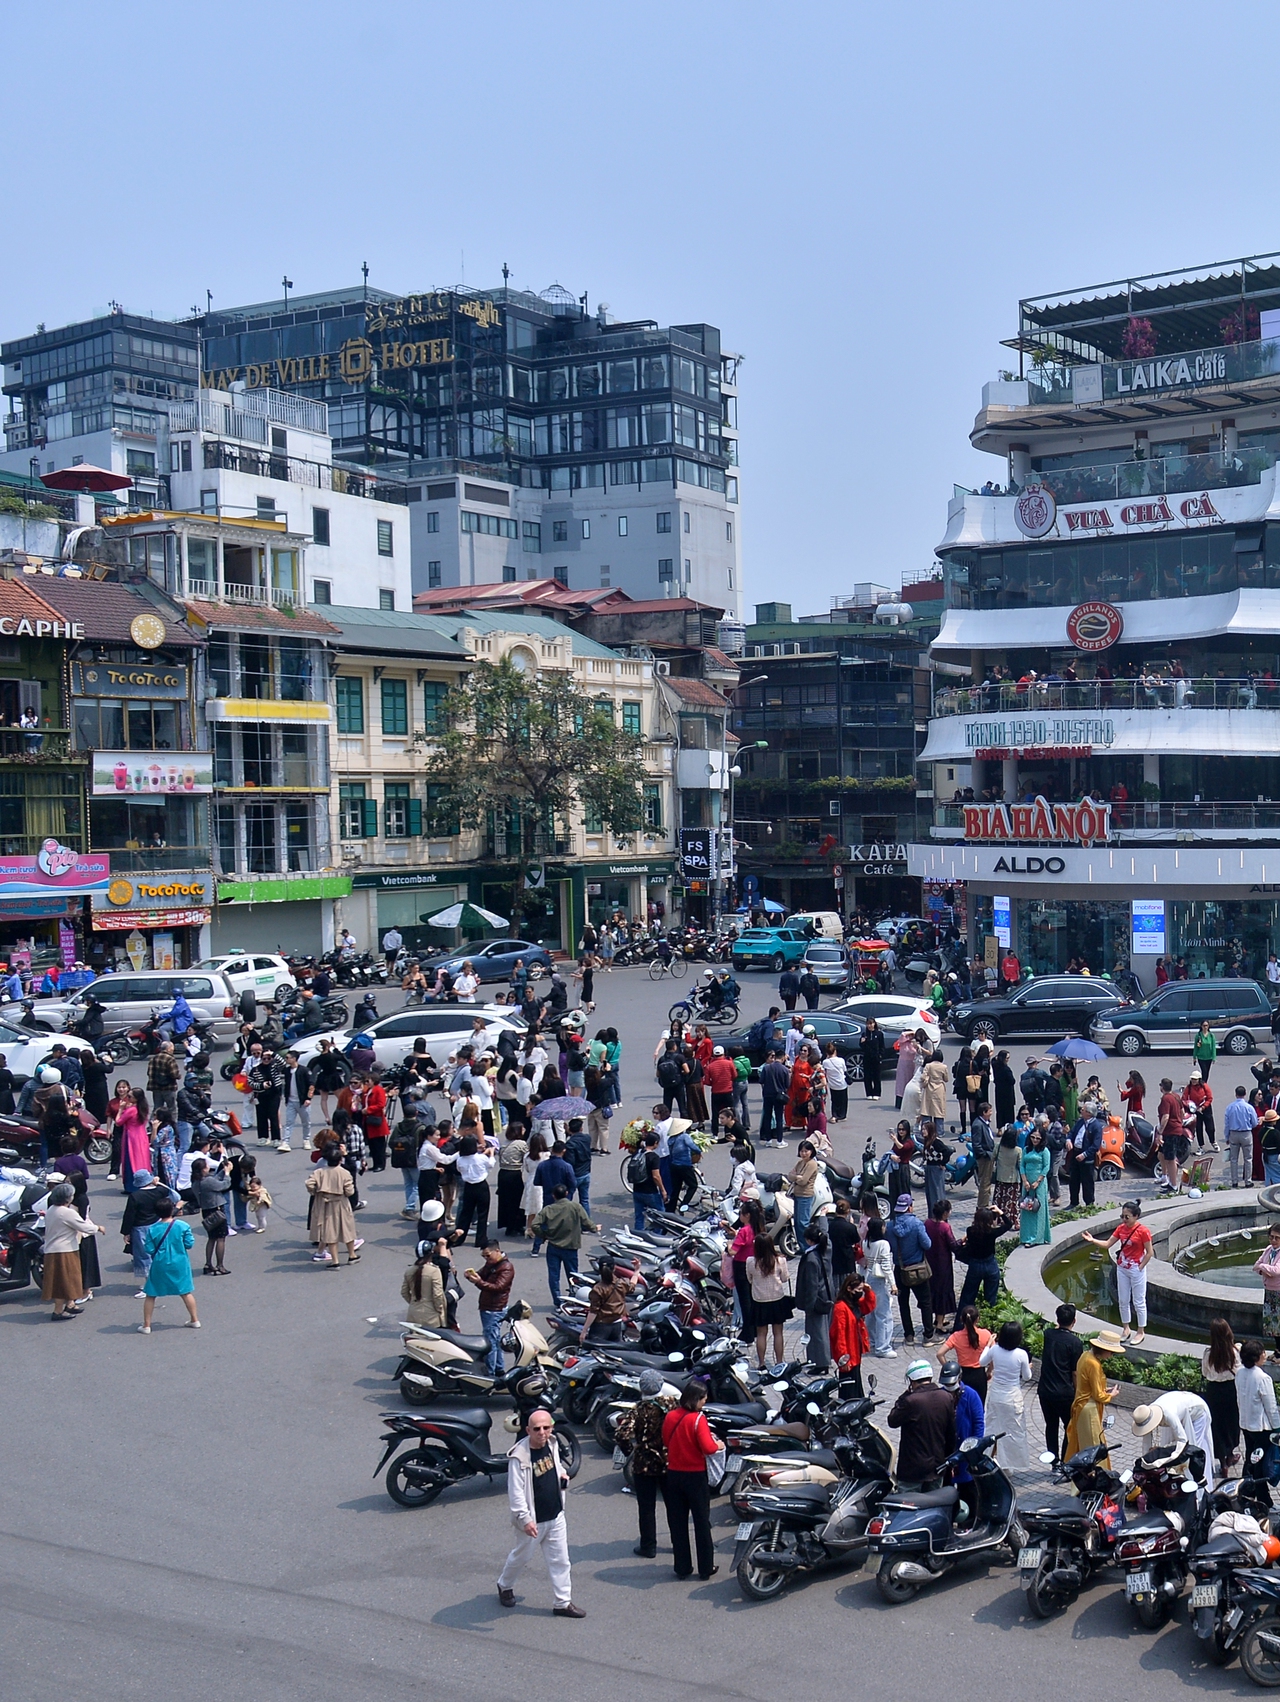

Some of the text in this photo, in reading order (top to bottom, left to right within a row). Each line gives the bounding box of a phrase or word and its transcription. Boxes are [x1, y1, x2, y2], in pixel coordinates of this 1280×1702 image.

[408, 311, 449, 326] LOUNGE
[246, 363, 271, 388] DE
[275, 354, 331, 384] VILLE
[381, 338, 455, 370] HOTEL
[1117, 353, 1227, 393] LAIKA Café
[1064, 491, 1216, 532] VUA CHẢ CÁ
[1070, 605, 1118, 626] HIGHLANDS
[1076, 635, 1113, 648] COFFEE
[1010, 720, 1047, 745] 1930
[1053, 719, 1115, 744] BISTRO
[975, 748, 1010, 761] COFFEE
[1023, 746, 1092, 760] RESTAURANT
[963, 795, 1111, 848] BIA HÀ NỘI
[687, 841, 703, 851] FS
[849, 844, 908, 861] KAFA
[684, 855, 708, 867] SPA
[993, 856, 1066, 874] ALDO
[609, 865, 649, 873] Vietcombank
[863, 864, 894, 875] Café
[382, 874, 437, 885] Vietcombank
[1203, 937, 1226, 947] Minh
